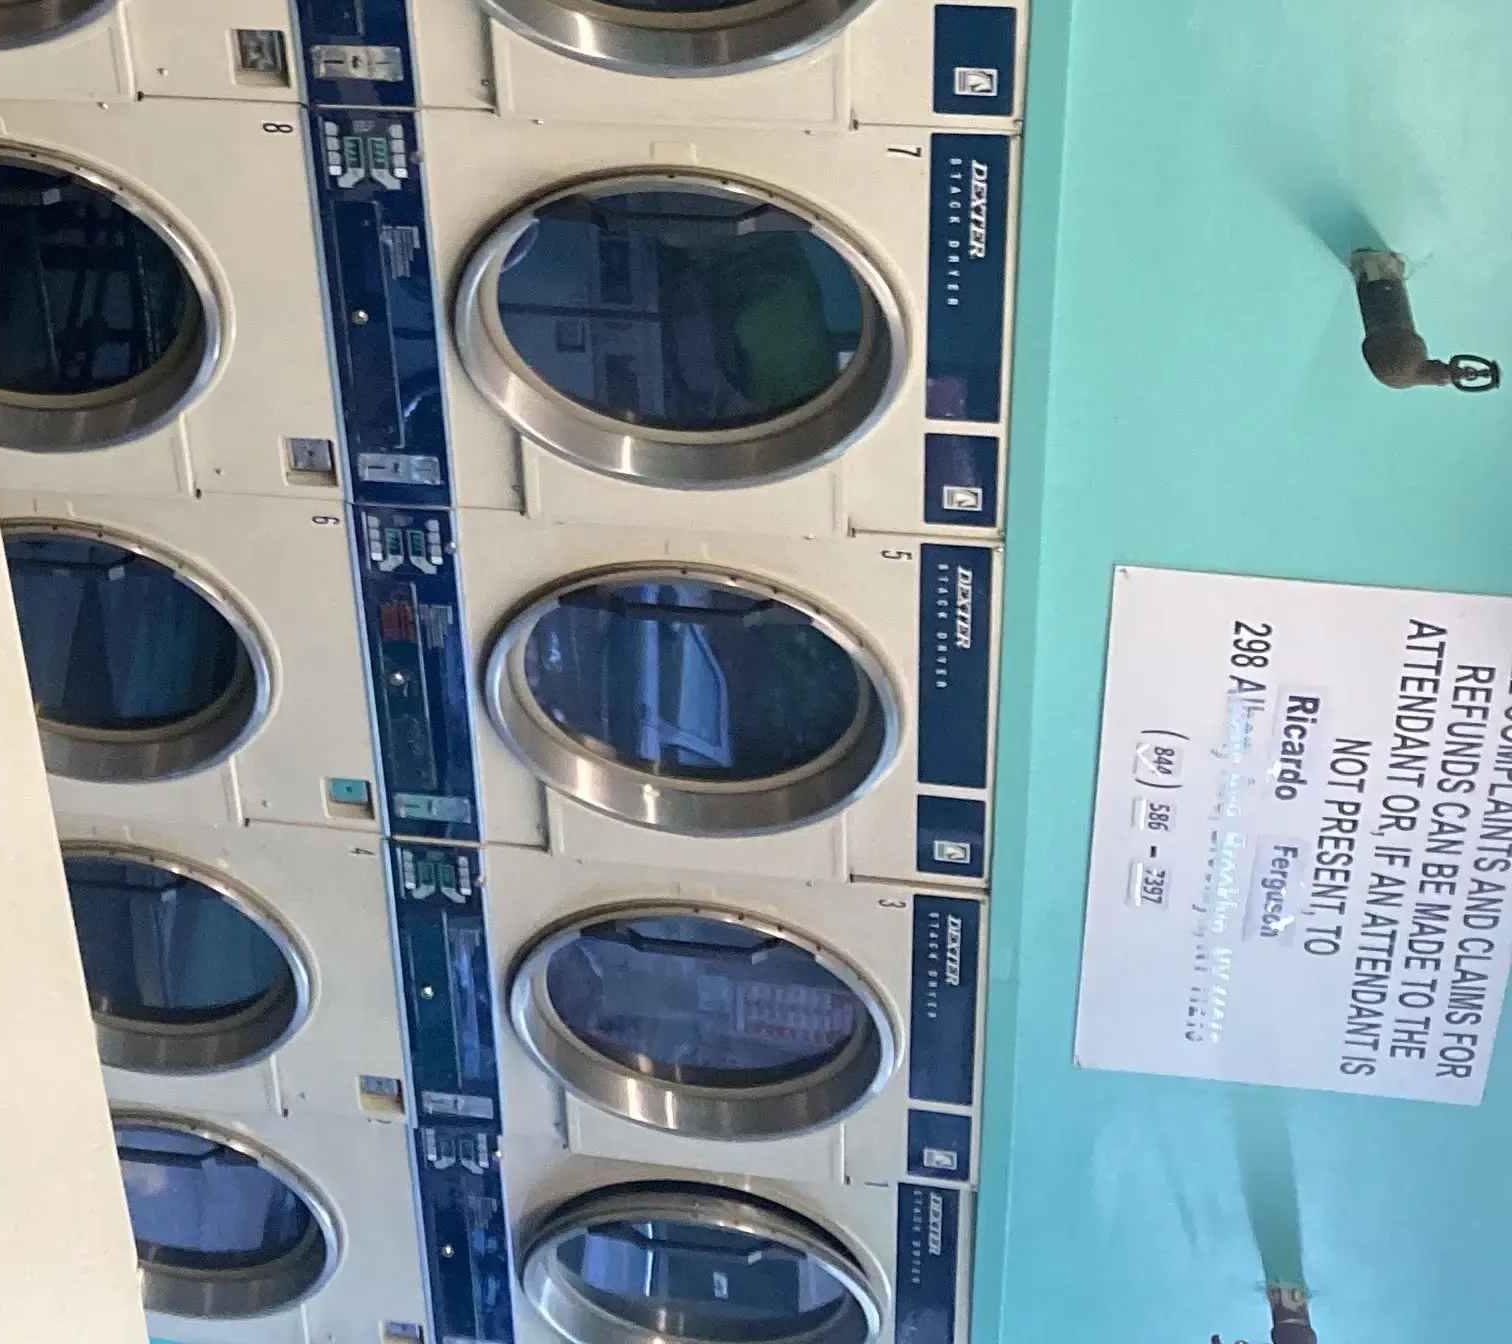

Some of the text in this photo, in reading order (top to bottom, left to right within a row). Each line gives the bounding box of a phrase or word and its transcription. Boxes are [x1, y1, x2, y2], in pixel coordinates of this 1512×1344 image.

[262, 122, 293, 134] 8
[887, 146, 920, 158] 7
[947, 158, 961, 306] STACK DRYER
[969, 159, 988, 259] DEXTER
[311, 515, 340, 526] 6
[880, 549, 911, 561] 5
[955, 566, 972, 649] DEXTER
[1230, 620, 1273, 669] 298
[1148, 803, 1169, 833] 586
[1260, 694, 1320, 938] Ricardo Ferguson
[350, 847, 375, 857] 4
[1301, 738, 1371, 957] NOT PRESENT, TO
[1340, 618, 1447, 1076] ATTENDANT OR, IF AN ATTENDANT IS
[1390, 664, 1496, 1060] REFUNDS CAN BE MADE TO THE
[877, 898, 905, 909] 3
[1142, 868, 1165, 905] 7397
[1462, 879, 1503, 930] AND
[945, 914, 961, 986] DEXTER
[1446, 937, 1492, 1026] CLAIMS
[1436, 1033, 1477, 1079] FOR
[928, 1192, 942, 1256] DEXTER
